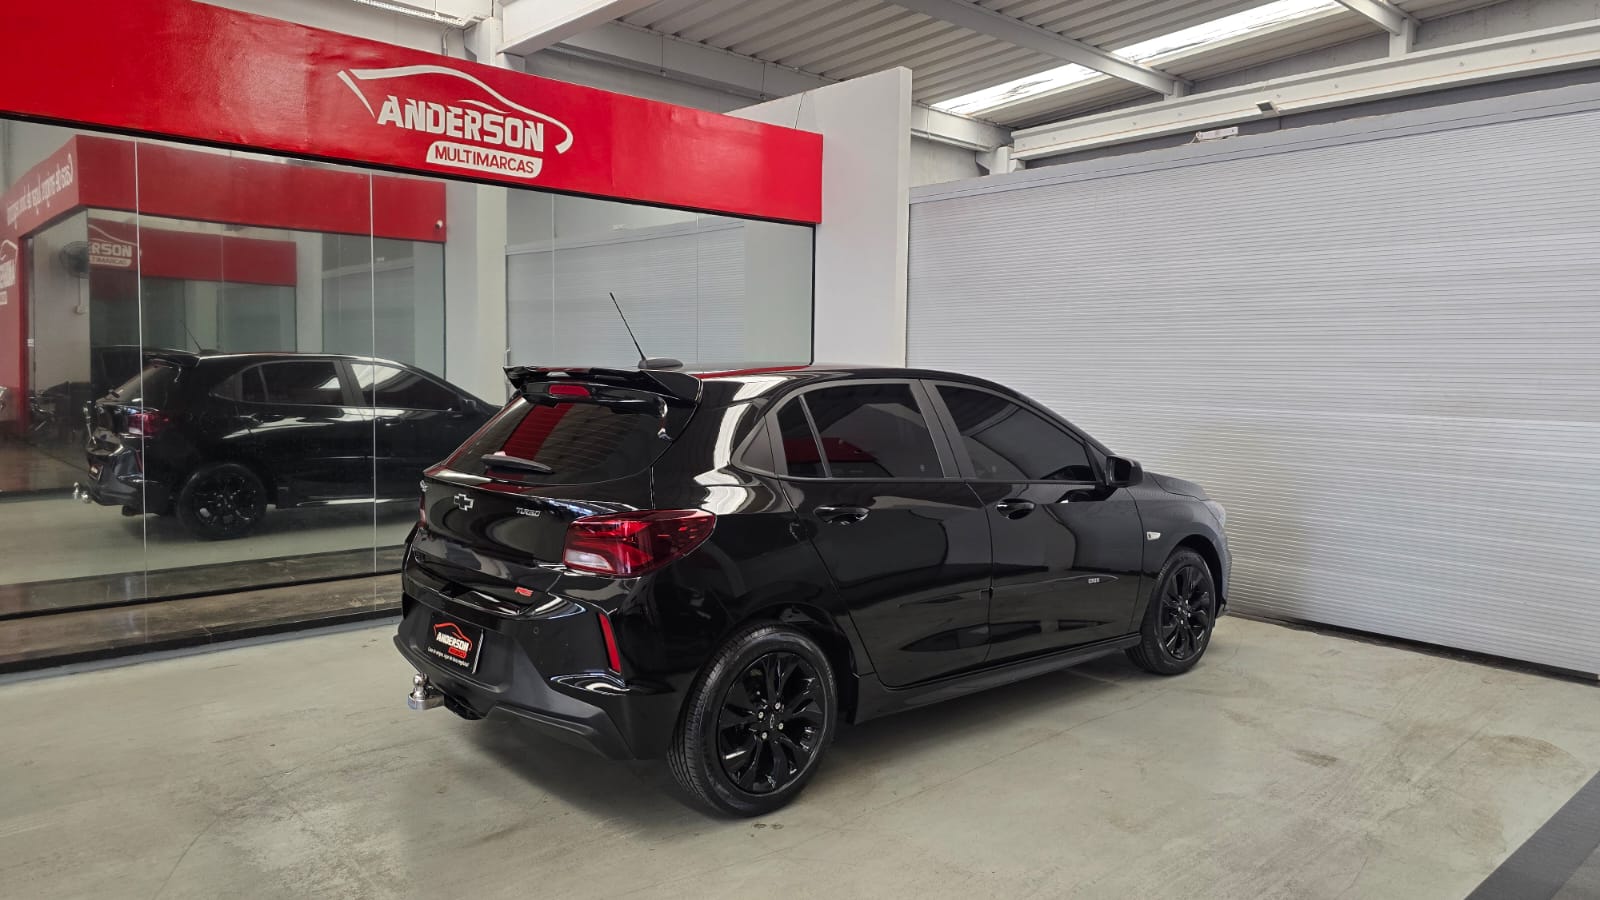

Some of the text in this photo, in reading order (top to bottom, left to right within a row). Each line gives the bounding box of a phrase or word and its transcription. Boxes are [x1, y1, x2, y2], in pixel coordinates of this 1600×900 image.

[377, 95, 544, 152] ANDERSON
[435, 145, 534, 174] MULTIMARCAS
[89, 242, 132, 258] RSON
[516, 507, 541, 517] TURBO
[436, 632, 470, 652] ANDERSON
